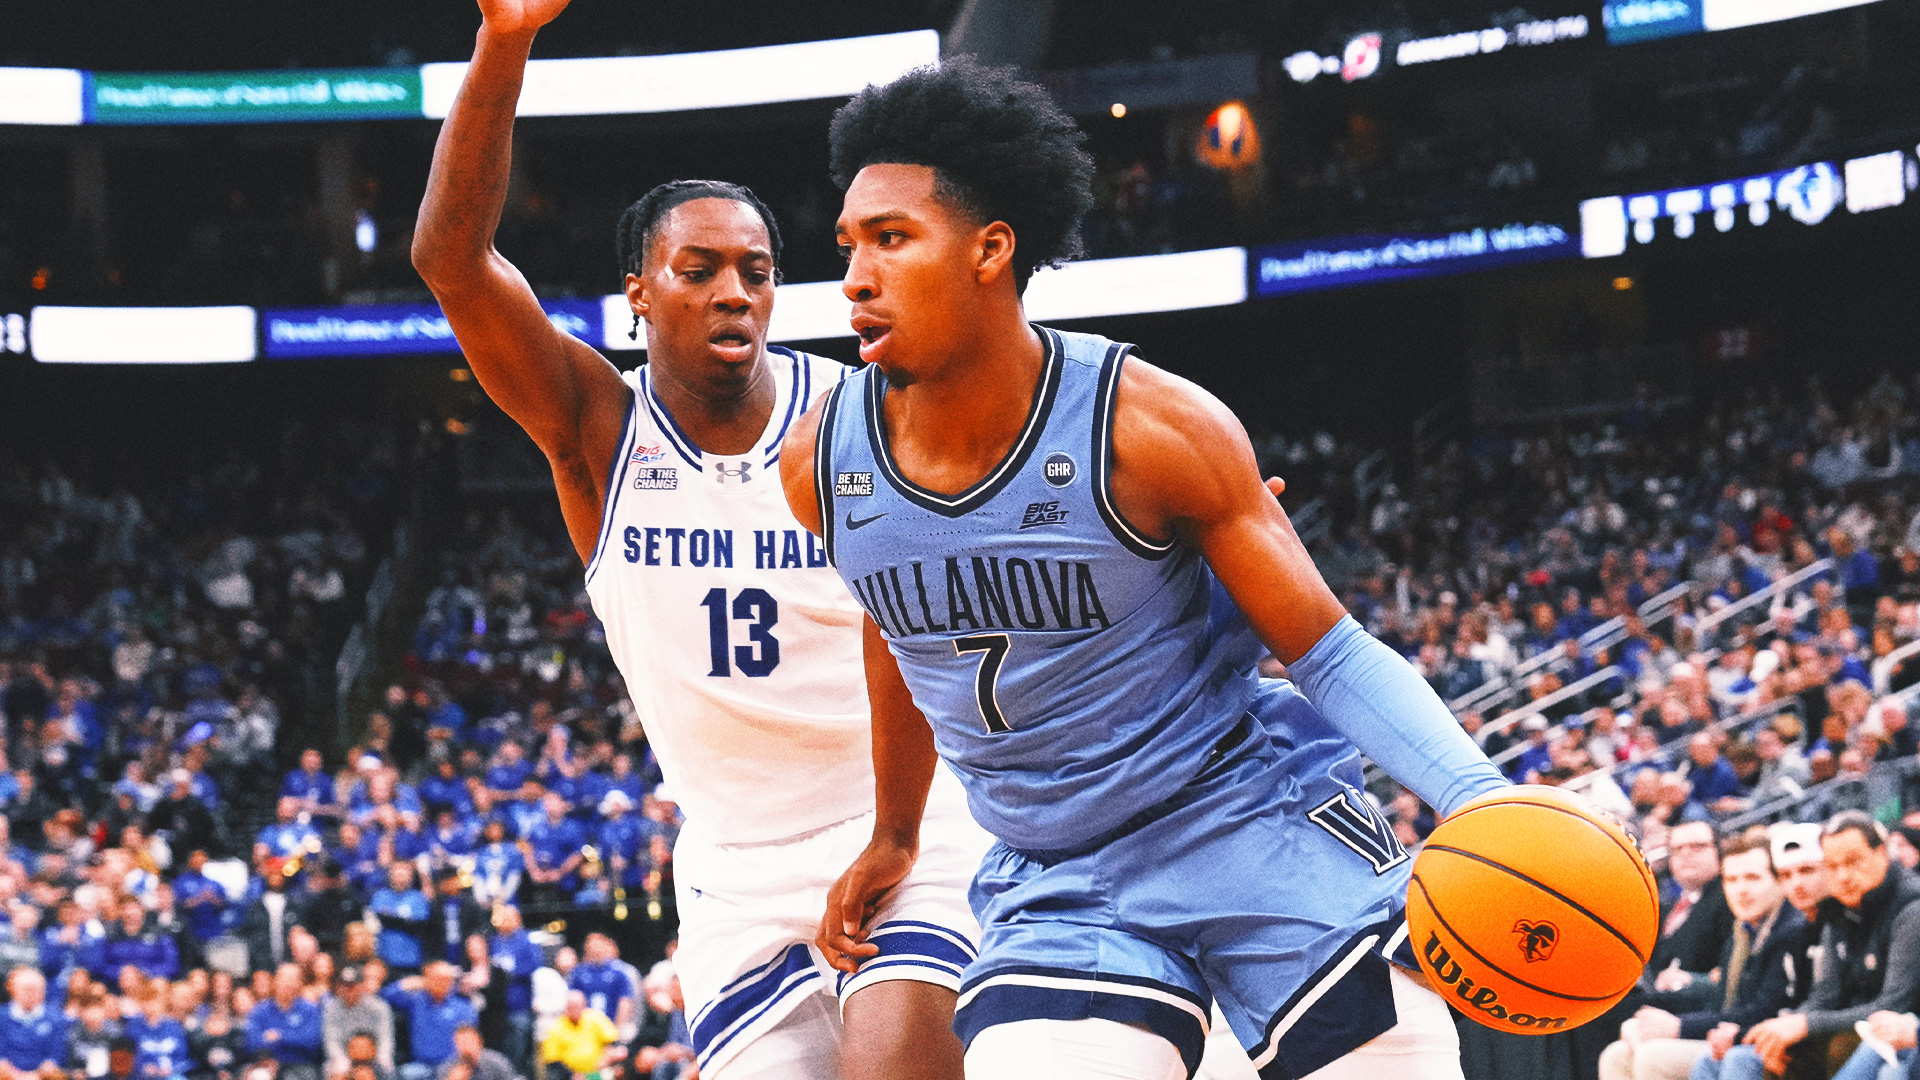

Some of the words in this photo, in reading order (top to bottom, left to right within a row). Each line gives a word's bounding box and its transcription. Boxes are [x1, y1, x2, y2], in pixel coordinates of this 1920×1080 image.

[636, 445, 660, 455] BIG
[638, 468, 654, 479] BE
[656, 468, 677, 479] THE
[1047, 462, 1071, 477] GHR
[634, 478, 678, 490] CHANGE
[837, 473, 852, 484] BE
[852, 472, 872, 484] THE
[835, 483, 873, 496] CHANGE
[1025, 501, 1060, 514] BIG
[1021, 510, 1070, 525] EAST
[623, 525, 734, 569] SETON
[752, 529, 829, 570] HAL
[852, 556, 1112, 640] VILLANOVA
[699, 586, 781, 678] 13
[952, 632, 1014, 735] 7
[1424, 929, 1569, 1030] Wilson
